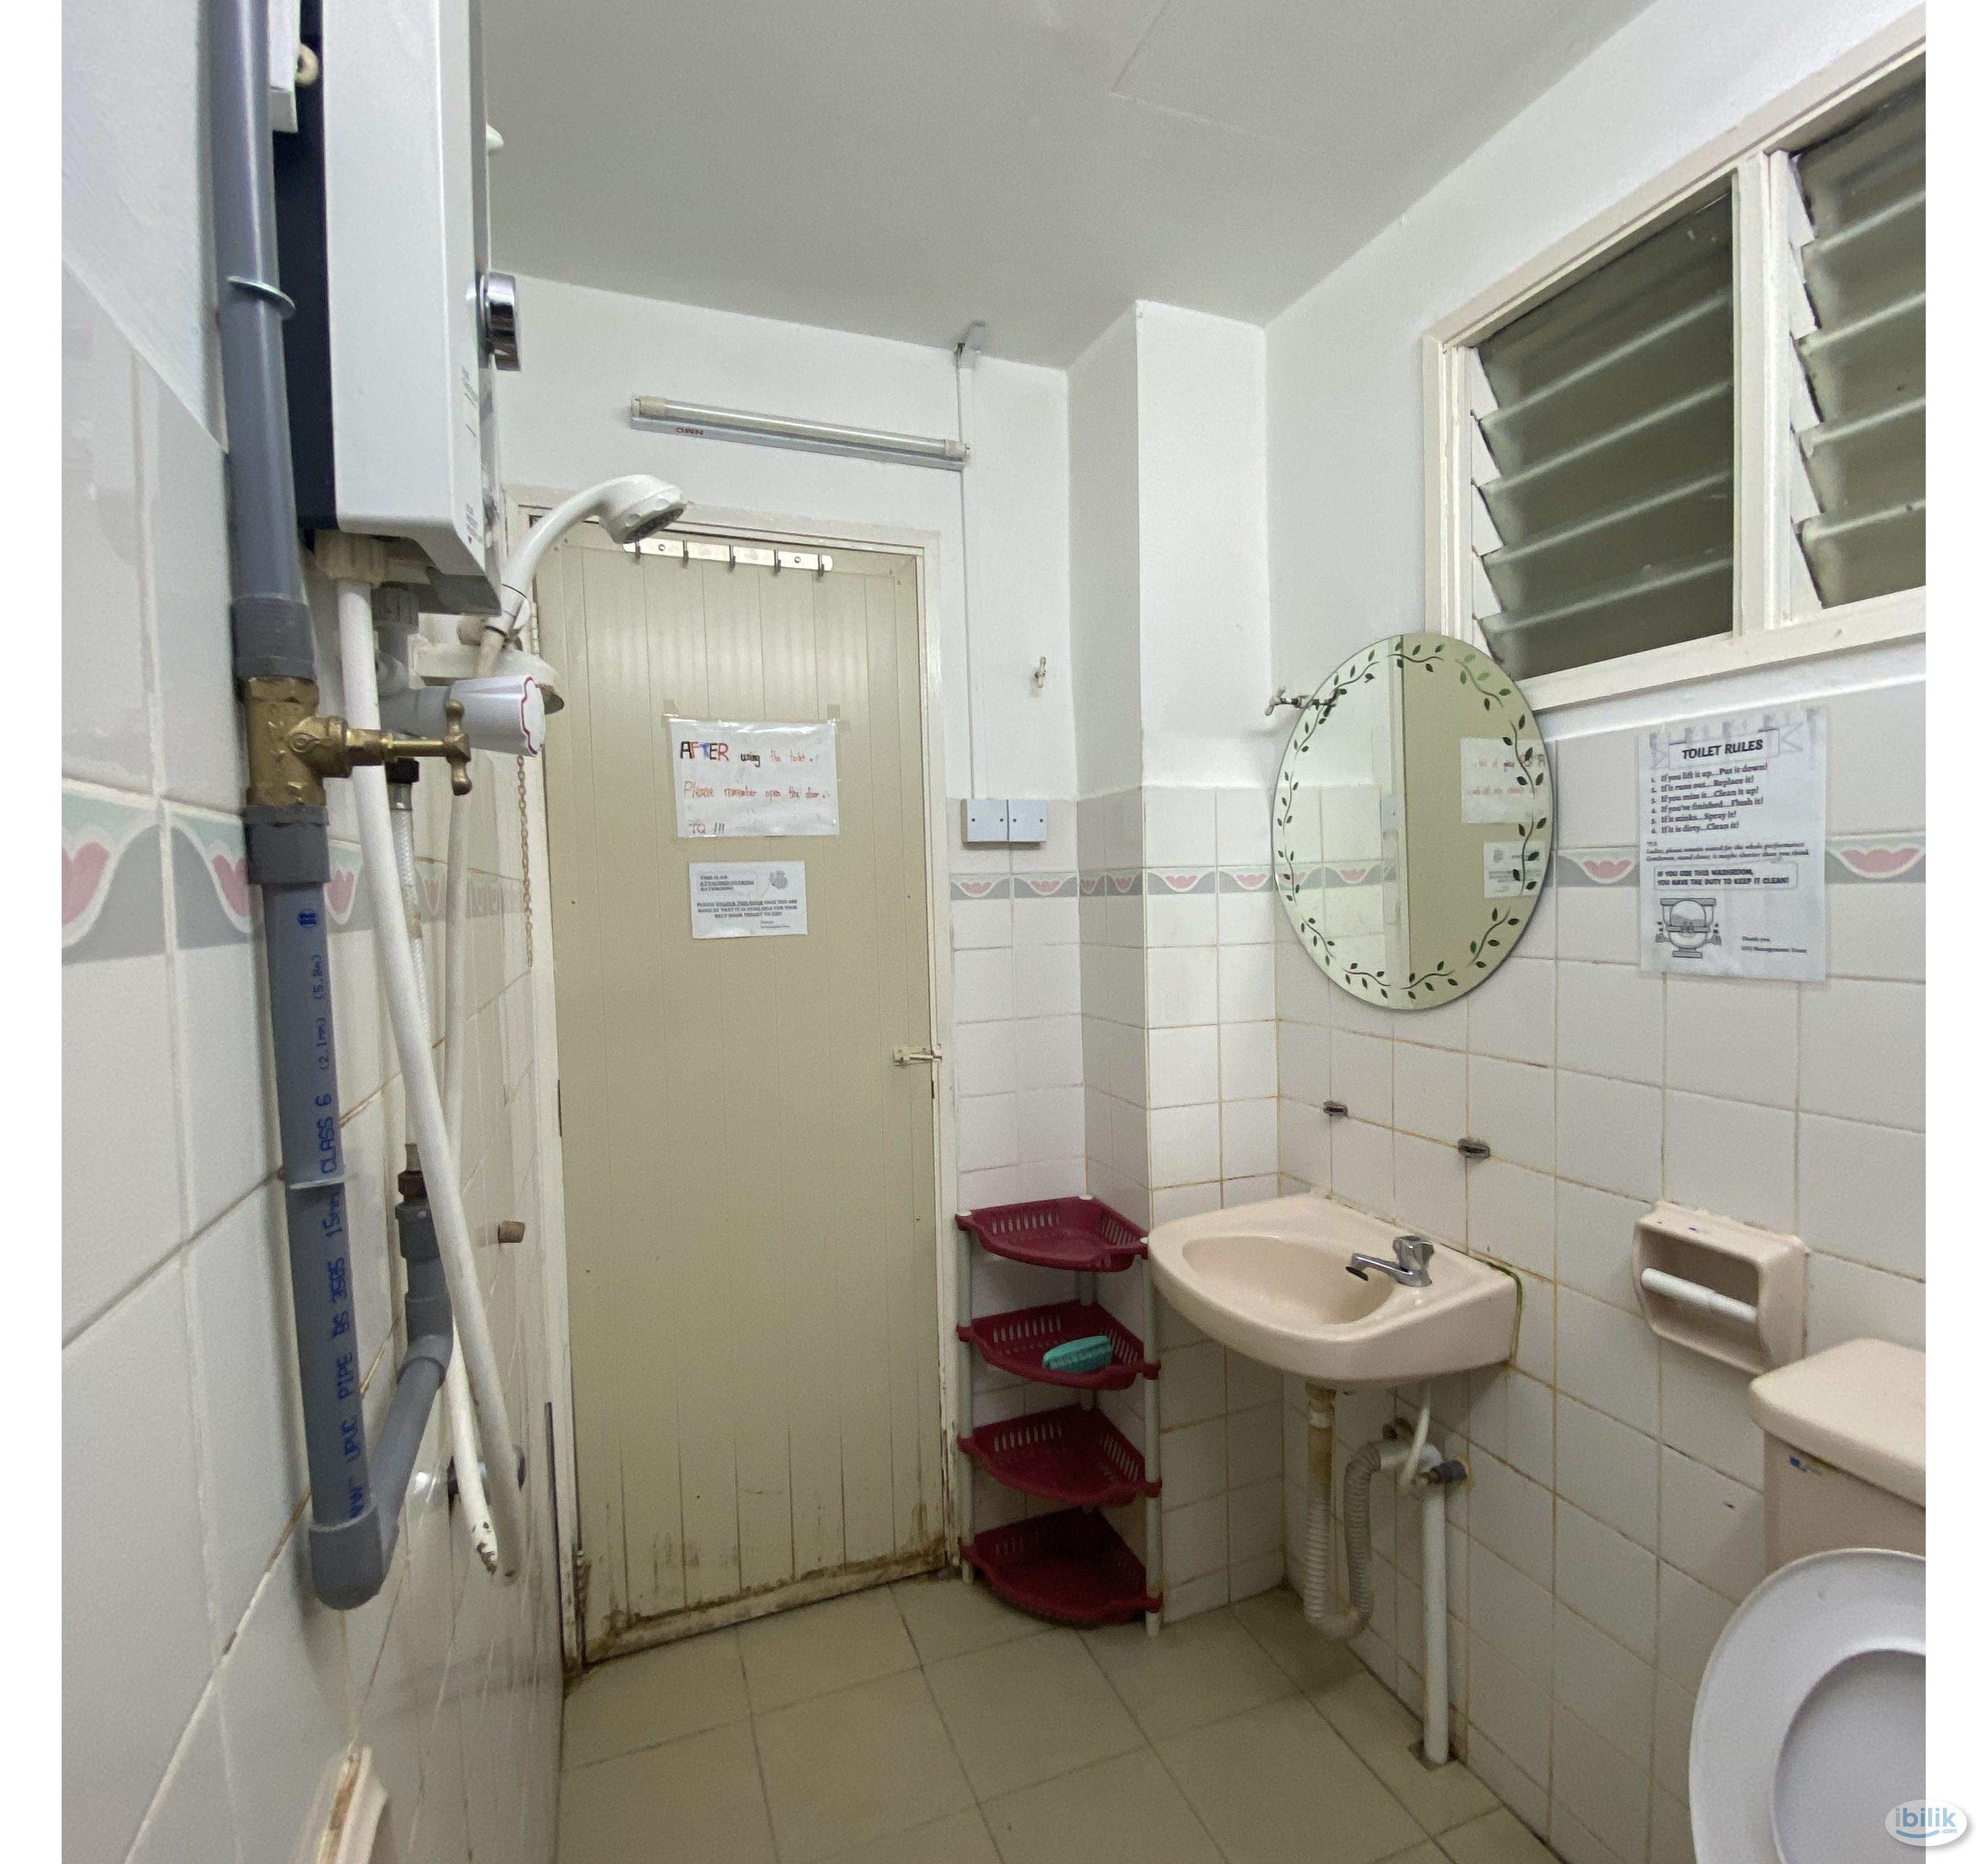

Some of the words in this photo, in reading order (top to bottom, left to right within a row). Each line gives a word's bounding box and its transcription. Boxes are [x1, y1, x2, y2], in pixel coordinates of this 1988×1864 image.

[679, 741, 730, 762] AFTER
[740, 752, 761, 768] using
[770, 749, 782, 762] the
[1682, 745, 1722, 759] TOILET
[1724, 739, 1763, 754] RULES
[1661, 774, 1668, 782] If
[1668, 775, 1682, 783] you
[1682, 771, 1693, 780] lift
[1741, 762, 1767, 772] down!
[1745, 775, 1754, 783] it!
[684, 780, 715, 799] Please
[724, 785, 758, 798] remember
[765, 790, 782, 803] open
[788, 785, 801, 799] the
[1668, 796, 1682, 804] you
[1746, 785, 1759, 796] up!
[1754, 796, 1764, 805] it!
[1727, 810, 1736, 819] it!
[689, 822, 707, 835] TQ
[1661, 825, 1668, 833] If
[1730, 820, 1739, 828] it!
[315, 1093, 332, 1108] 6
[319, 1116, 338, 1174] CLASS
[337, 1351, 353, 1400] PIPE
